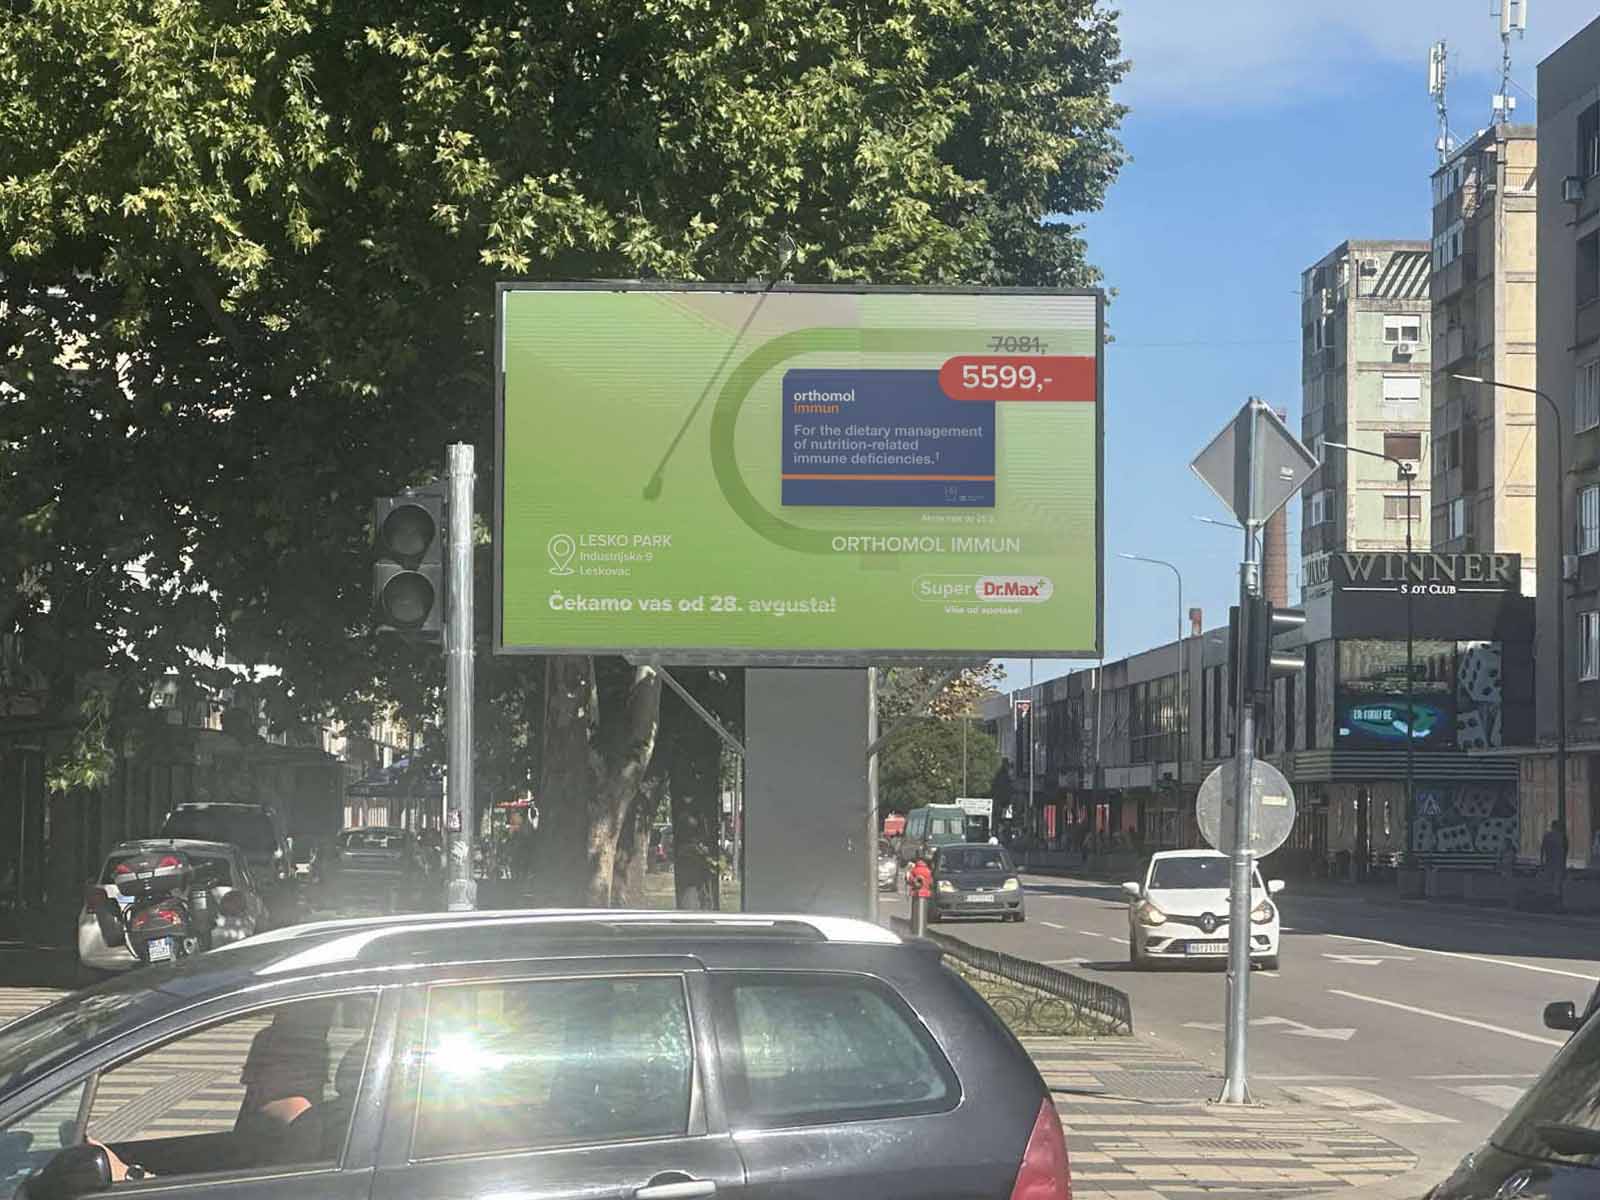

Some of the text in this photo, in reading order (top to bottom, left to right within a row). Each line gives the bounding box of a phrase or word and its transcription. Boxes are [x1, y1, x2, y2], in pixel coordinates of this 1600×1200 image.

[962, 365, 1052, 392] 5599,-
[793, 389, 855, 402] orthomol
[793, 403, 840, 414] immun
[793, 424, 983, 440] For the dietary management
[793, 438, 919, 451] of nutrition-related
[793, 453, 847, 465] immune
[580, 534, 672, 547] LESKO PARK
[831, 536, 1021, 552] ORTHOMOL IMMUN
[580, 565, 631, 576] Leskovac
[1338, 553, 1516, 582] WINNER
[920, 581, 972, 598] Super
[1429, 584, 1456, 594] CLUB
[549, 590, 836, 616] Čekamo vas od 28. avgusta!
